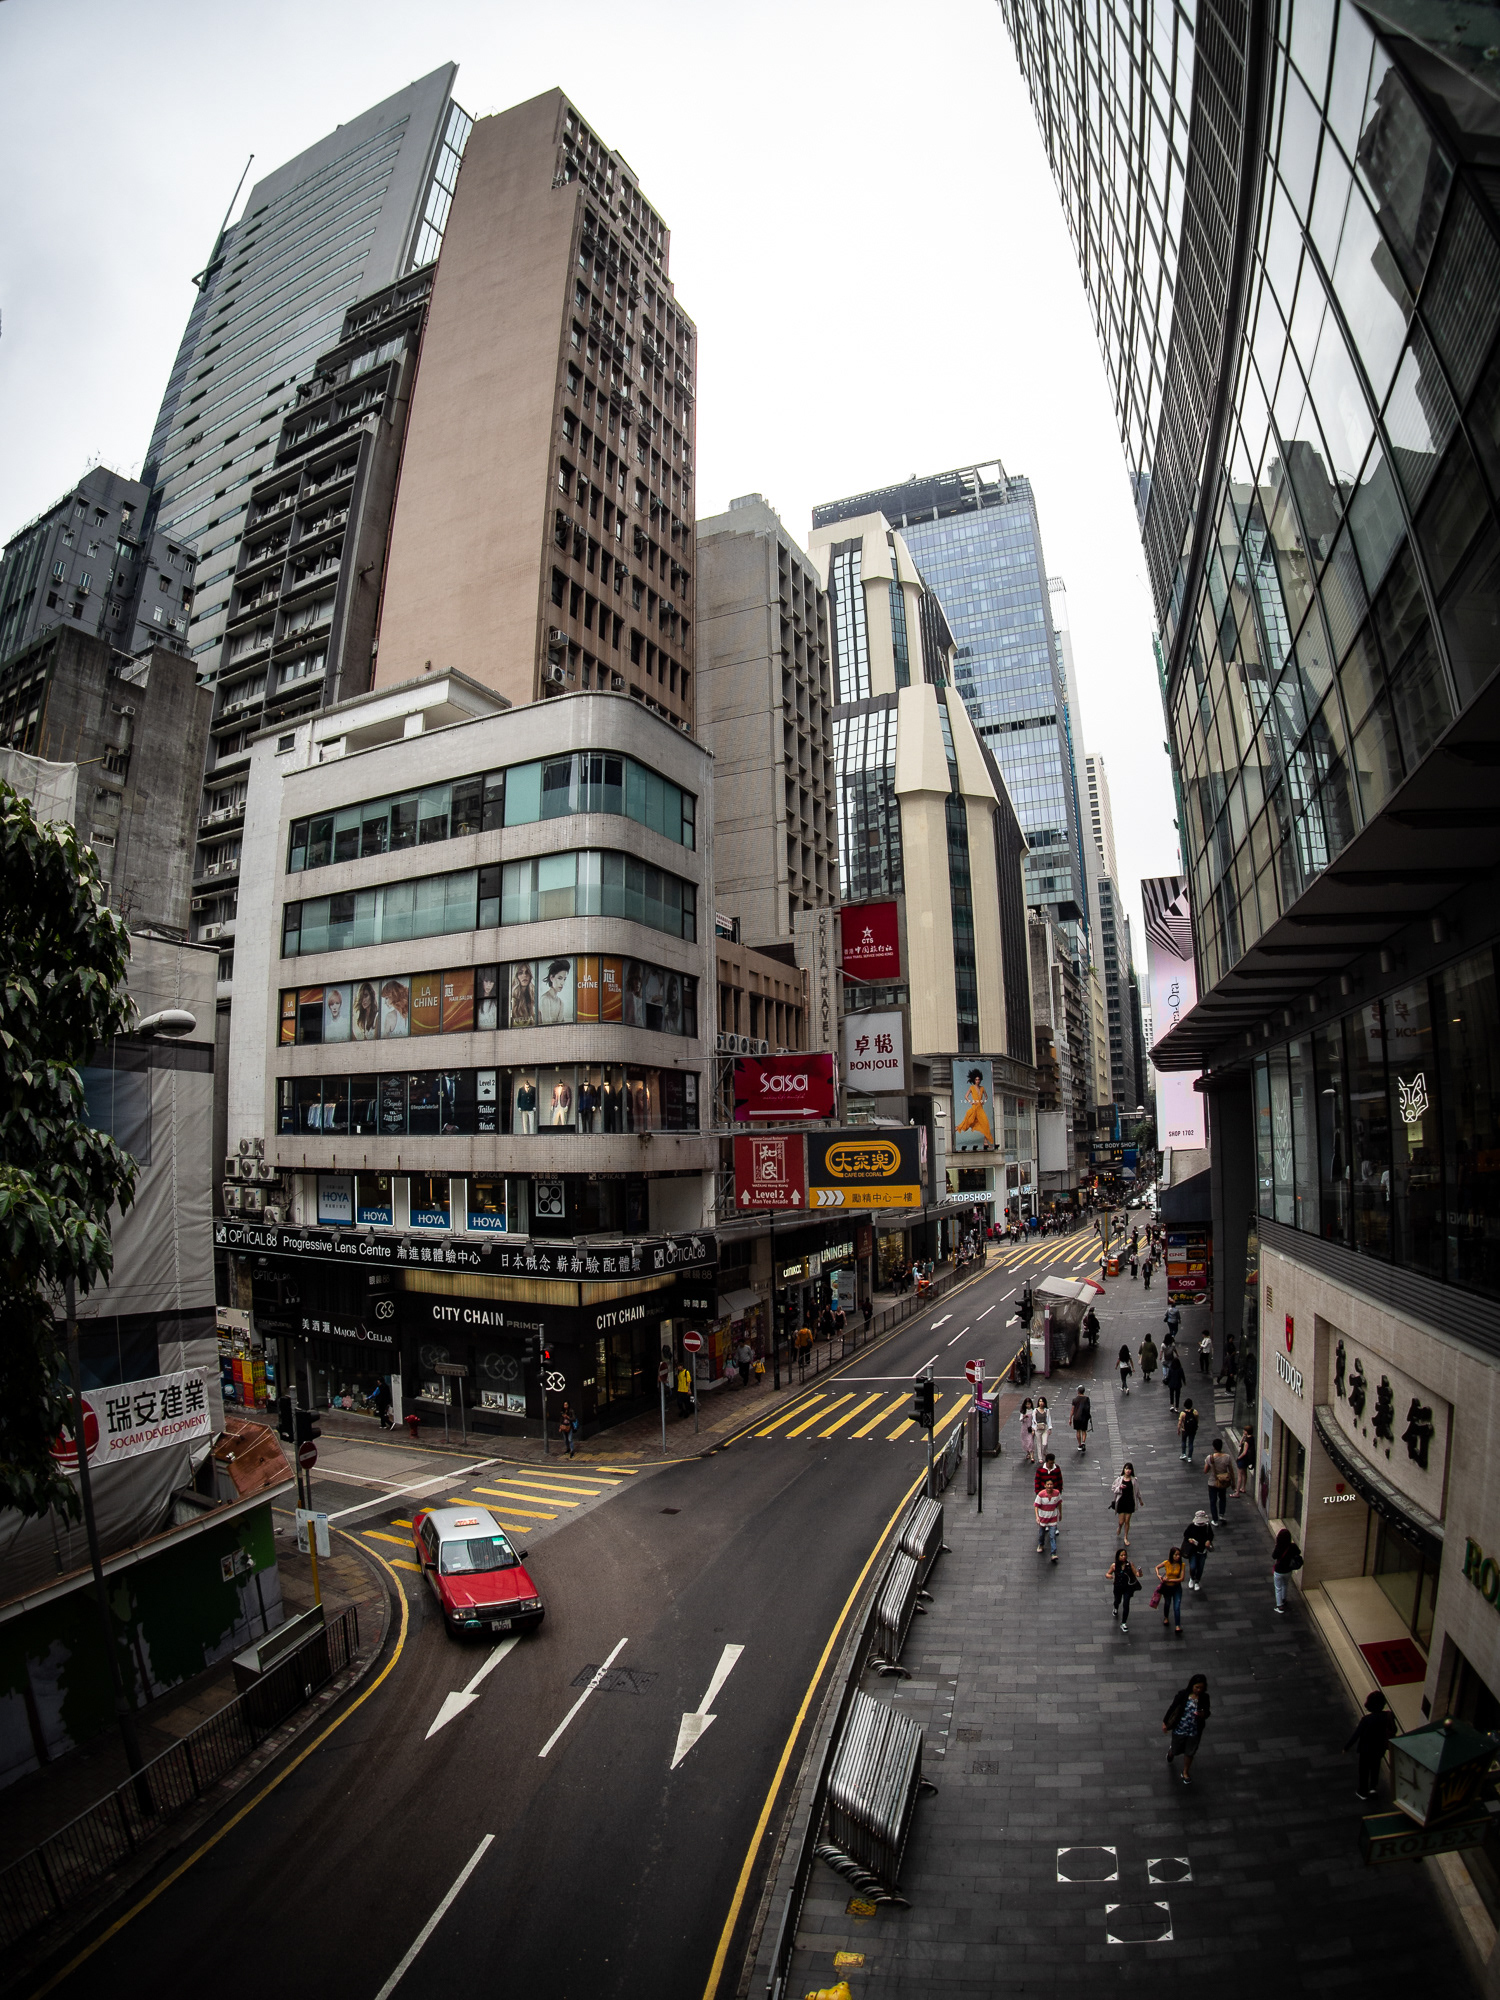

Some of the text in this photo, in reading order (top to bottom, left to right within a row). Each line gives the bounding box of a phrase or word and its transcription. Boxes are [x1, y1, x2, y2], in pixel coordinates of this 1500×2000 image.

[422, 986, 431, 996] LA
[414, 996, 438, 1008] CHINE
[821, 976, 829, 1043] TRAVEL
[850, 1059, 898, 1071] BONJOUR
[478, 1105, 496, 1114] Tailor
[479, 1122, 496, 1131] Made
[323, 1192, 349, 1202] HOYA
[756, 1190, 784, 1198] Level 2
[952, 1193, 992, 1202] TOPSHOP
[364, 1211, 388, 1222] HOYA
[418, 1214, 445, 1225] HOYA
[472, 1216, 502, 1228] HOYA
[229, 1229, 391, 1258] OPTICAL 88 Progressive Lens Centre
[397, 1245, 481, 1265] 漸進鏡體驗中心
[666, 1246, 696, 1264] OPTICAL
[432, 1305, 538, 1330] CITY CHAIN PRIMO
[596, 1312, 617, 1330] CITY
[618, 1305, 645, 1324] CHAIN
[1276, 1351, 1303, 1398] TUDOR
[106, 1379, 205, 1434] 瑞安建業
[110, 1414, 206, 1450] SOCAM DEVELOPMENT
[1322, 1494, 1356, 1504] TUDOR
[1462, 1536, 1500, 1614] RO
[1376, 1826, 1481, 1859] ROLEX
